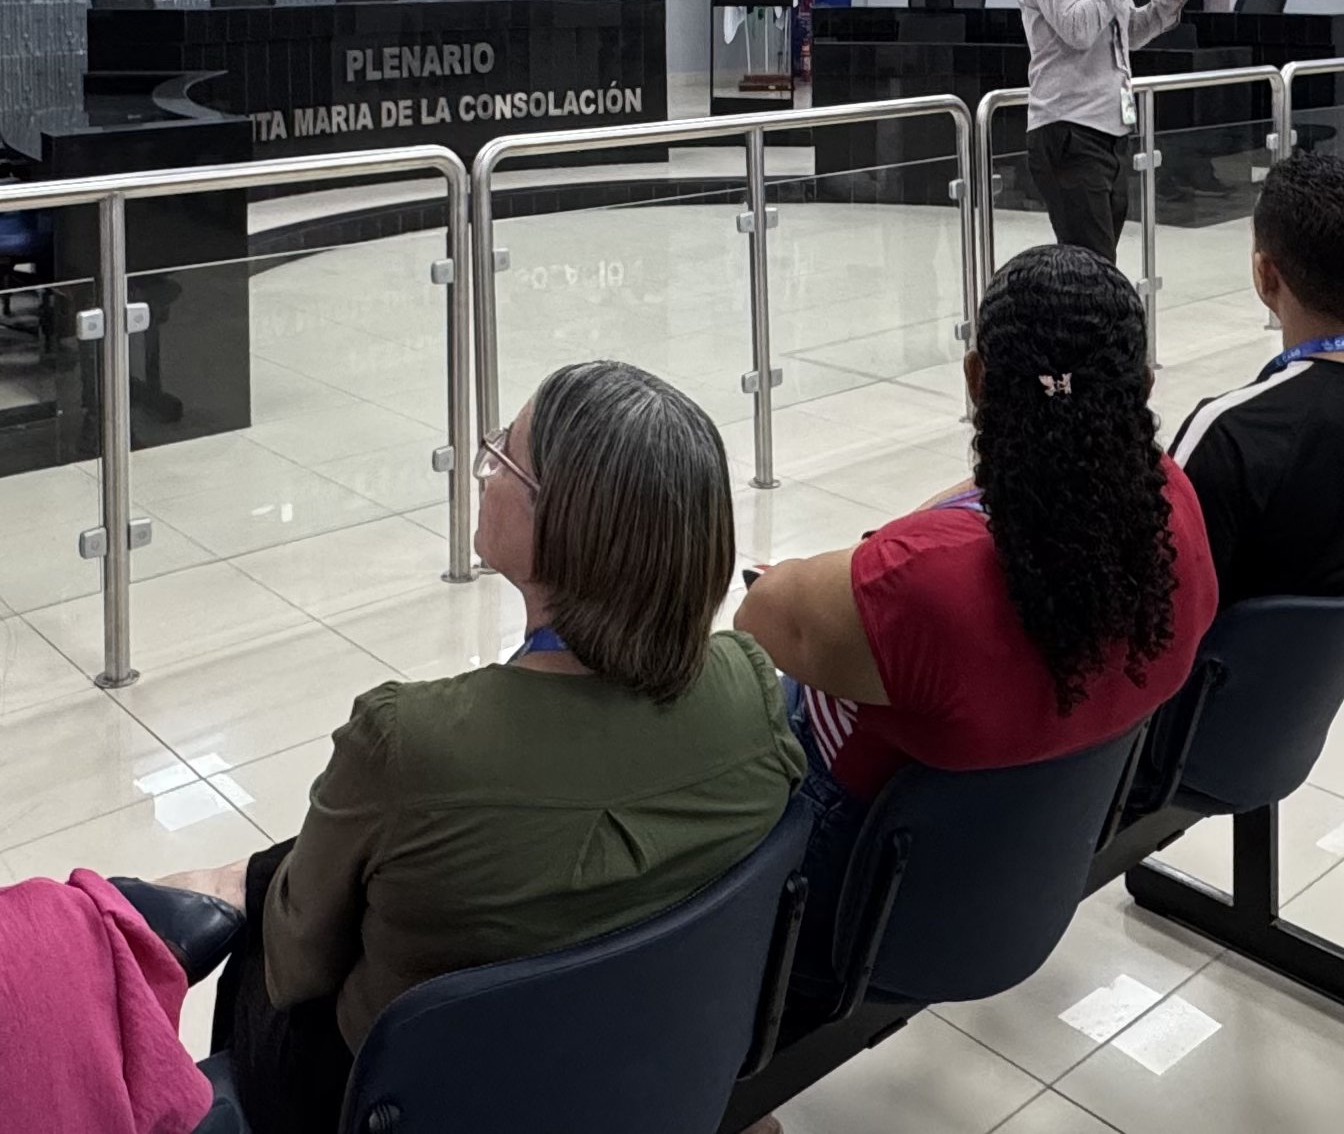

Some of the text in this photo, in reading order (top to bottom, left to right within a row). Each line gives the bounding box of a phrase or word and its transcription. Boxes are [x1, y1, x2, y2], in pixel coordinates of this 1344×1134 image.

[346, 42, 495, 82] PLENARIO
[293, 102, 374, 138] MARIA
[380, 99, 413, 129] DE
[420, 96, 452, 125] LA
[458, 81, 642, 122] CONSOLACIÓN
